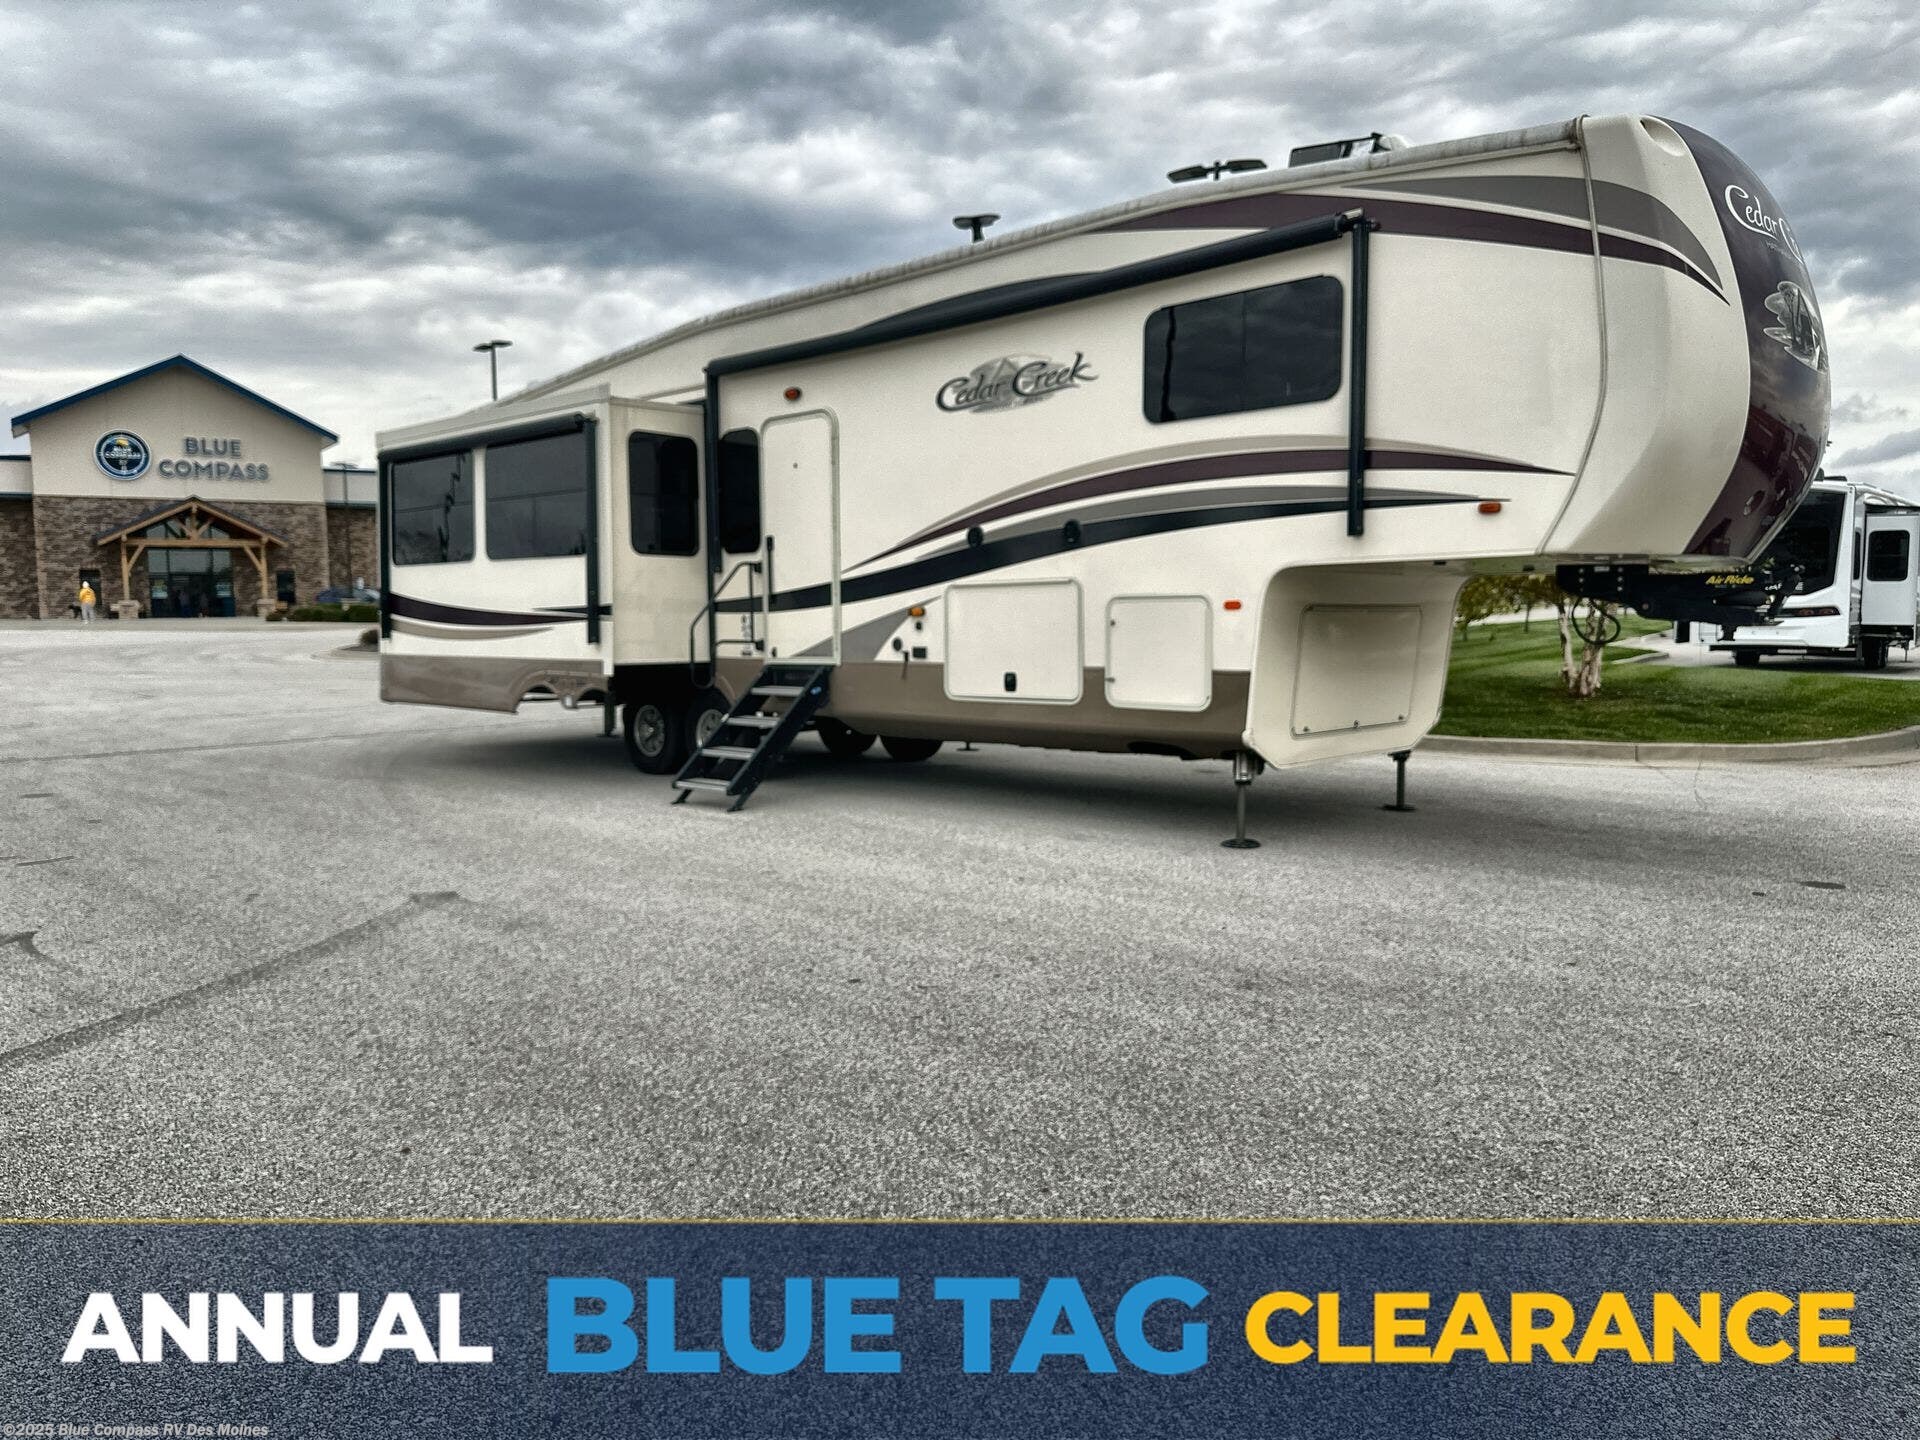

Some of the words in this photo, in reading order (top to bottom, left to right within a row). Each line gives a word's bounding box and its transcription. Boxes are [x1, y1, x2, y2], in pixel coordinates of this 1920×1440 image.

[1724, 184, 1778, 240] Cedar
[936, 374, 1001, 412] Cedar
[1012, 351, 1099, 396] Creek
[184, 437, 242, 458] BLUE
[158, 459, 269, 481] COMPASS
